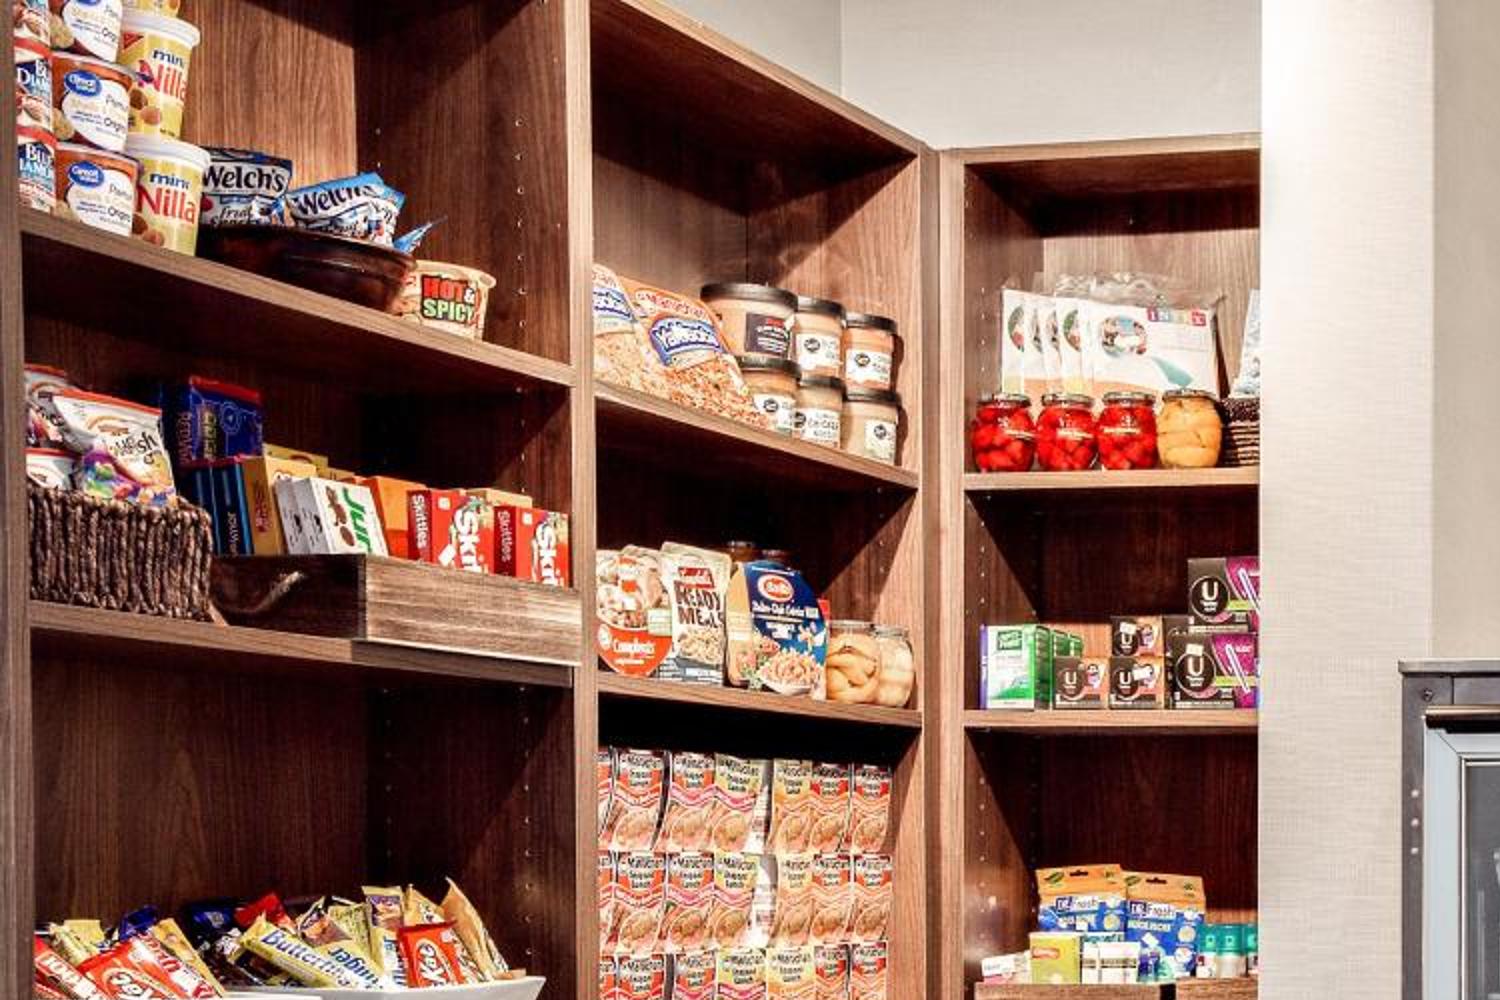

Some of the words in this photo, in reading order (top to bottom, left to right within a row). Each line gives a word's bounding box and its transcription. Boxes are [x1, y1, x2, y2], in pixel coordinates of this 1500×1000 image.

[200, 163, 286, 193] Welch's
[137, 183, 197, 225] Nilla
[423, 276, 466, 300] HOT
[463, 287, 476, 305] &
[412, 494, 428, 551] Skittles
[497, 510, 511, 564] Skittles
